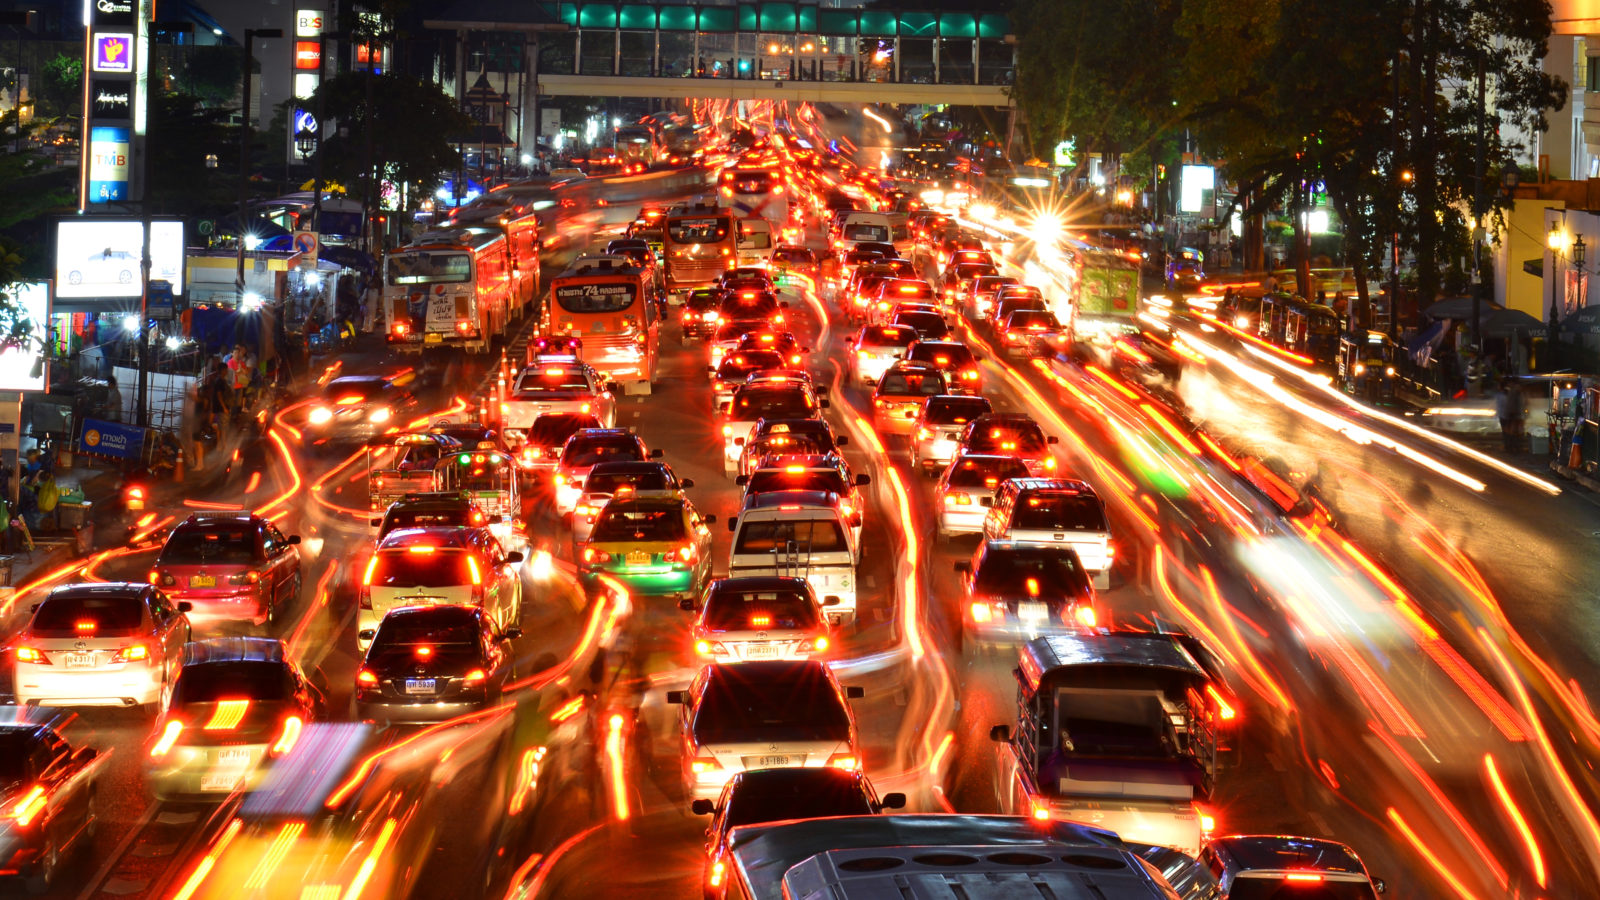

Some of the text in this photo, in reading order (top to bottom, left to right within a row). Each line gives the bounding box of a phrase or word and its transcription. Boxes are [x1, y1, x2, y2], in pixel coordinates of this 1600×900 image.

[300, 18, 322, 28] B2S
[96, 154, 126, 166] TMB
[583, 285, 599, 296] 74
[1528, 328, 1547, 336] VISA
[101, 441, 125, 450] ENTRANCE
